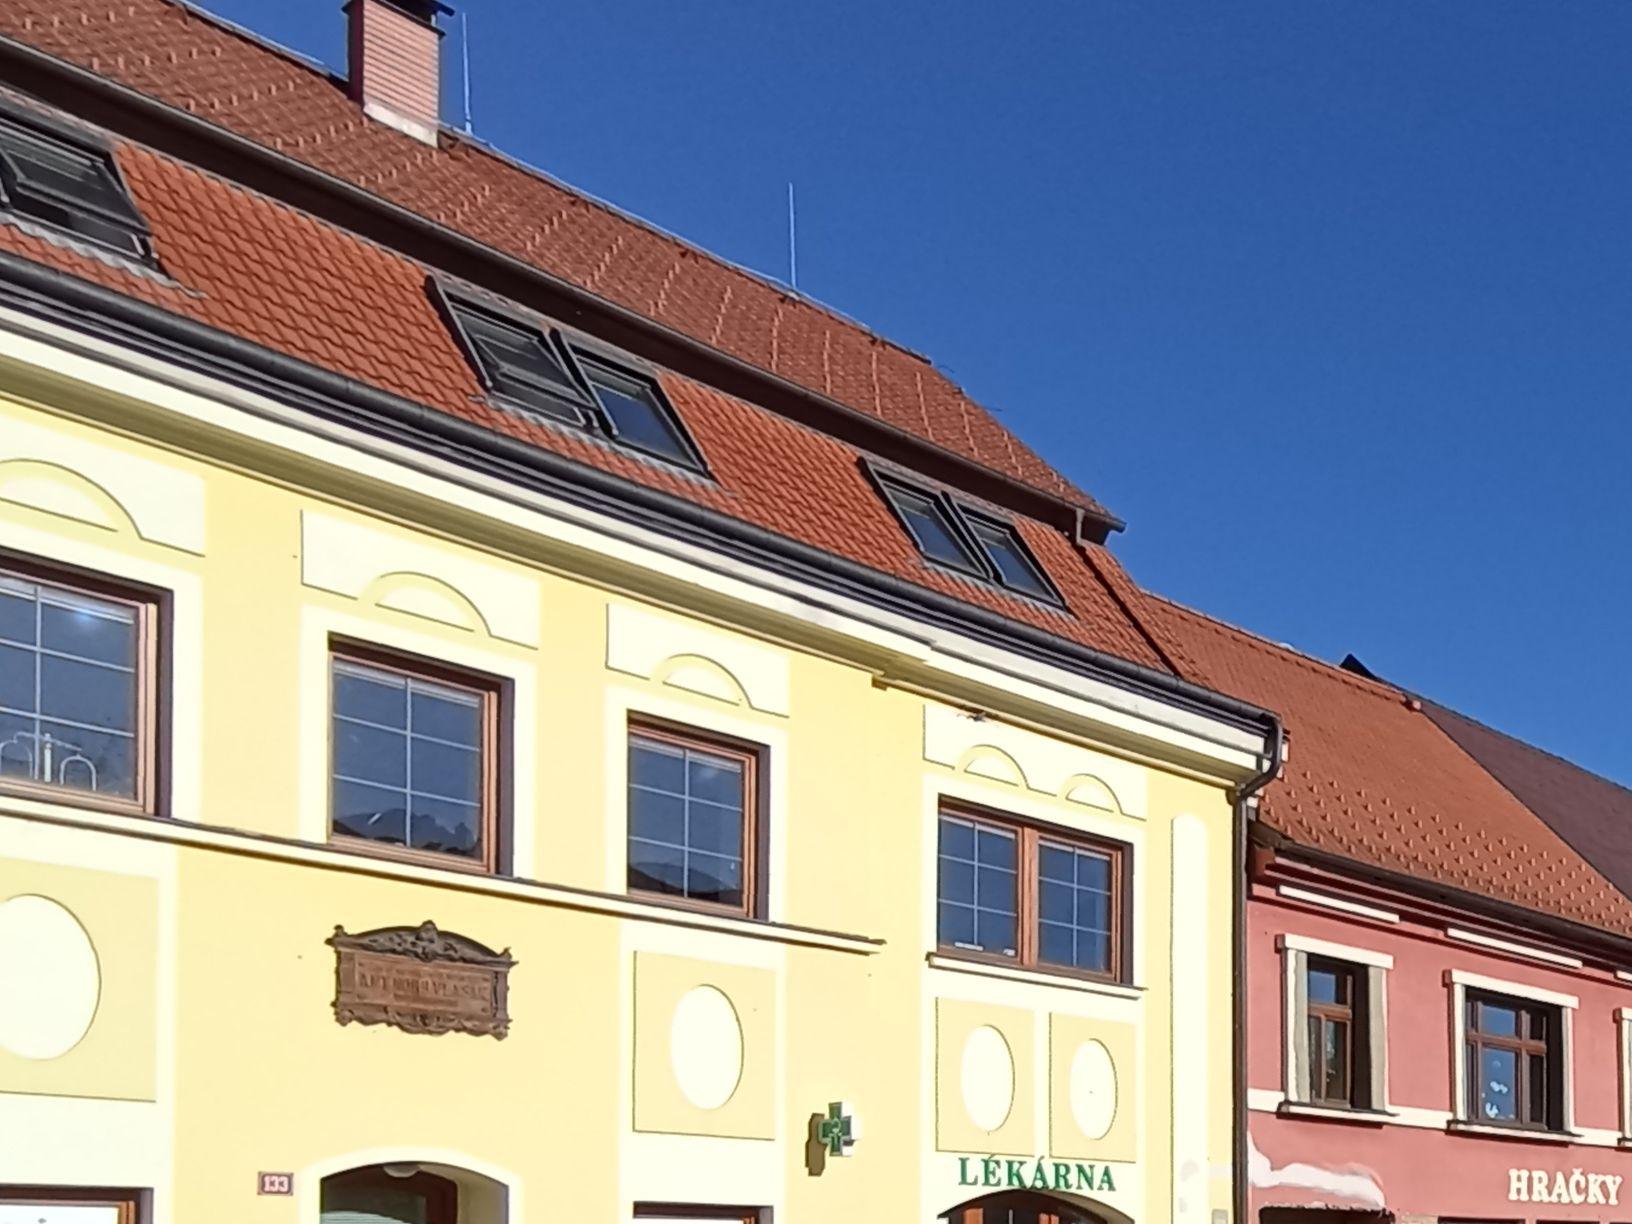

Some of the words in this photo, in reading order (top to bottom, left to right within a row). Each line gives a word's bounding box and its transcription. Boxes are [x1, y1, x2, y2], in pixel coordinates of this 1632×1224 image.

[264, 1174, 289, 1193] 133
[958, 1153, 1116, 1192] LÉKÁRNA
[1508, 1167, 1623, 1206] HRAČKY
